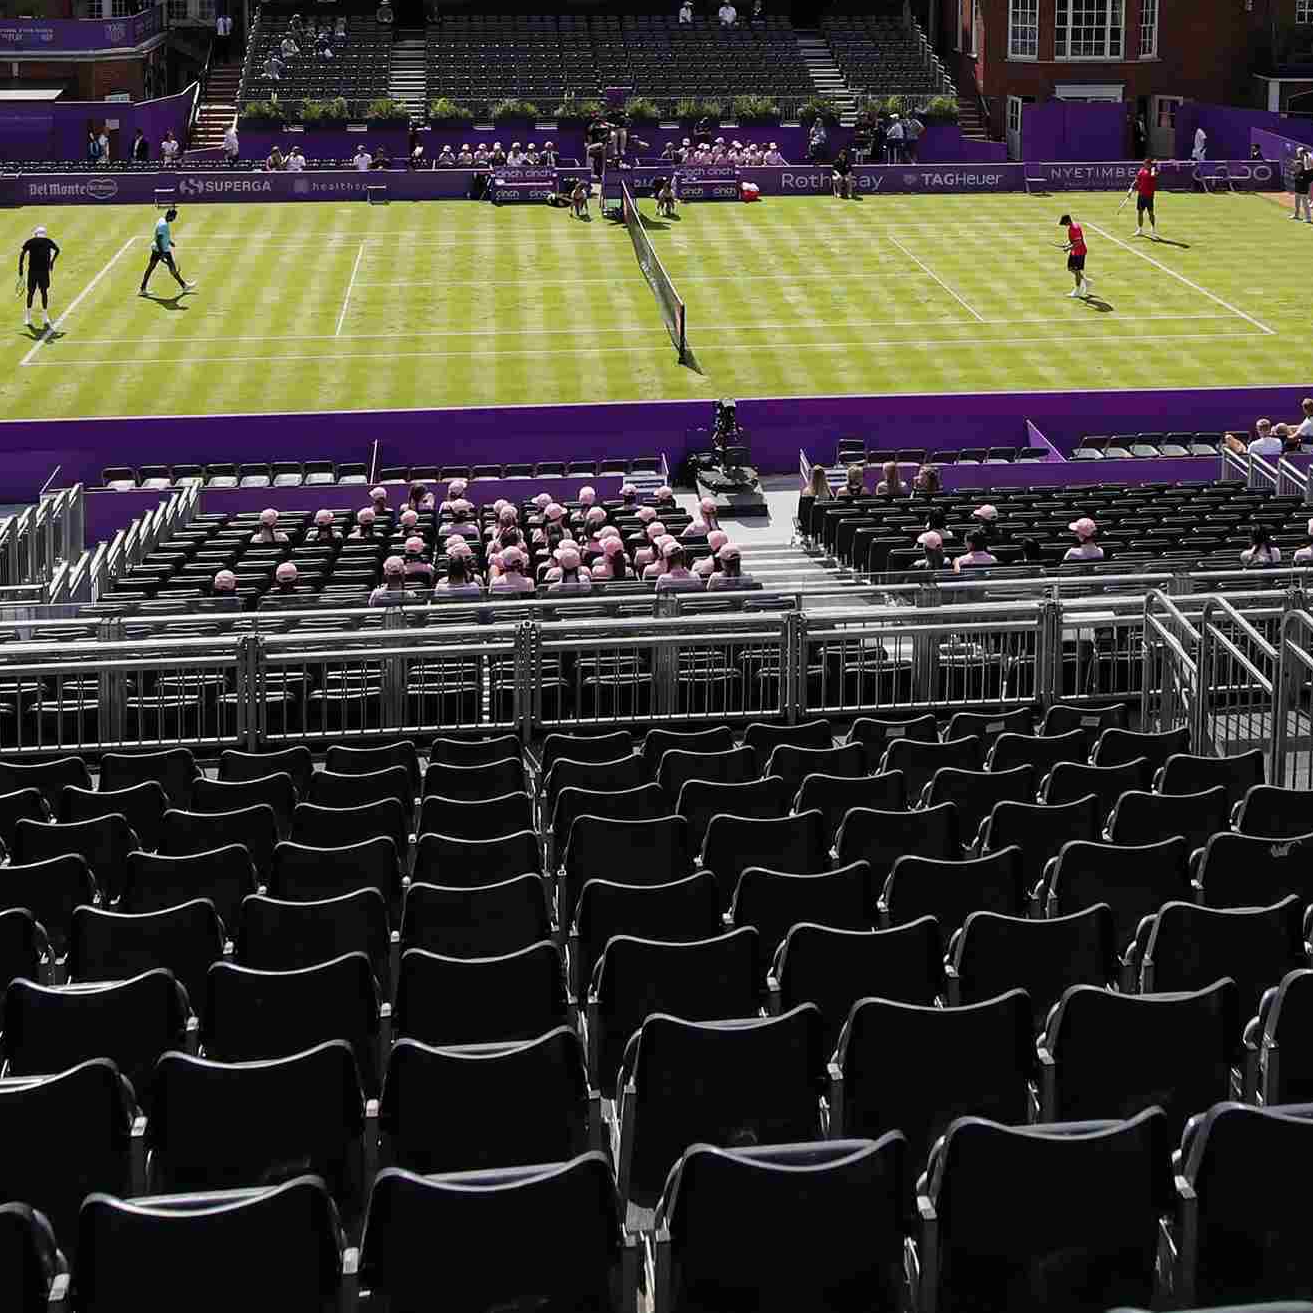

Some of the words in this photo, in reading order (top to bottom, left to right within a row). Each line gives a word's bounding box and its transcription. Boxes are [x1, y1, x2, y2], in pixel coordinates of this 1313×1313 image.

[1051, 167, 1137, 179] NYETIMBE
[205, 180, 272, 192] SUPERGA
[781, 173, 883, 190] Rothsay
[30, 182, 48, 195] Del
[49, 182, 86, 195] Monte
